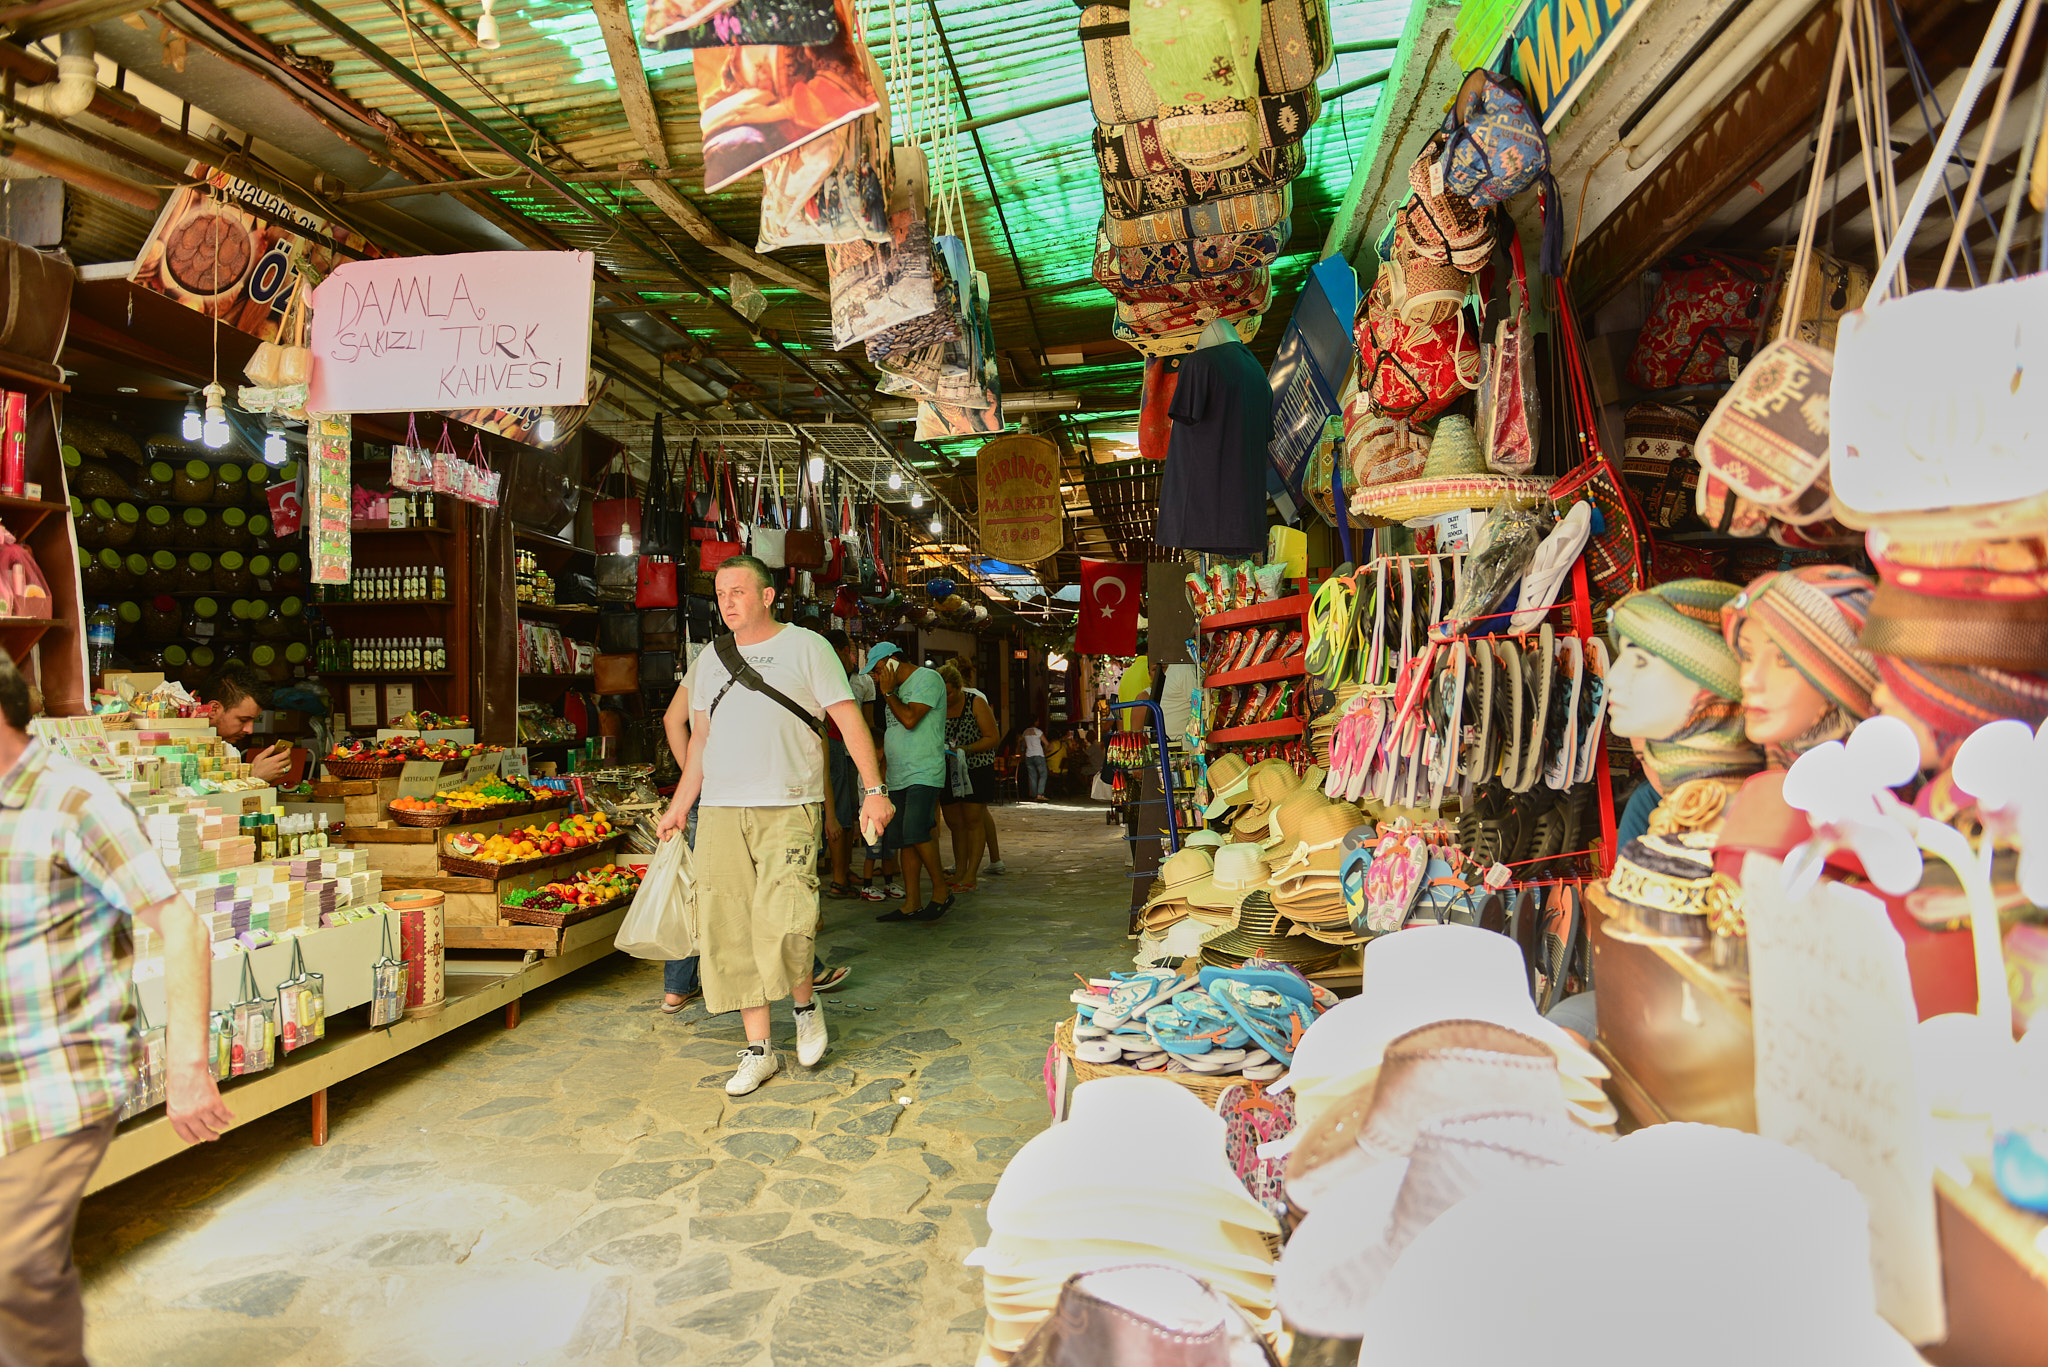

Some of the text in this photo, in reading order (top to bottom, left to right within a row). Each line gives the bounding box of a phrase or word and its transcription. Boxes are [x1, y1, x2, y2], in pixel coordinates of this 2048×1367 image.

[333, 273, 486, 337] DAMLA
[439, 322, 541, 362] TÜRK
[438, 357, 562, 400] KAHVESİ
[984, 495, 1055, 513] MARKET
[1001, 527, 1040, 543] 1948
